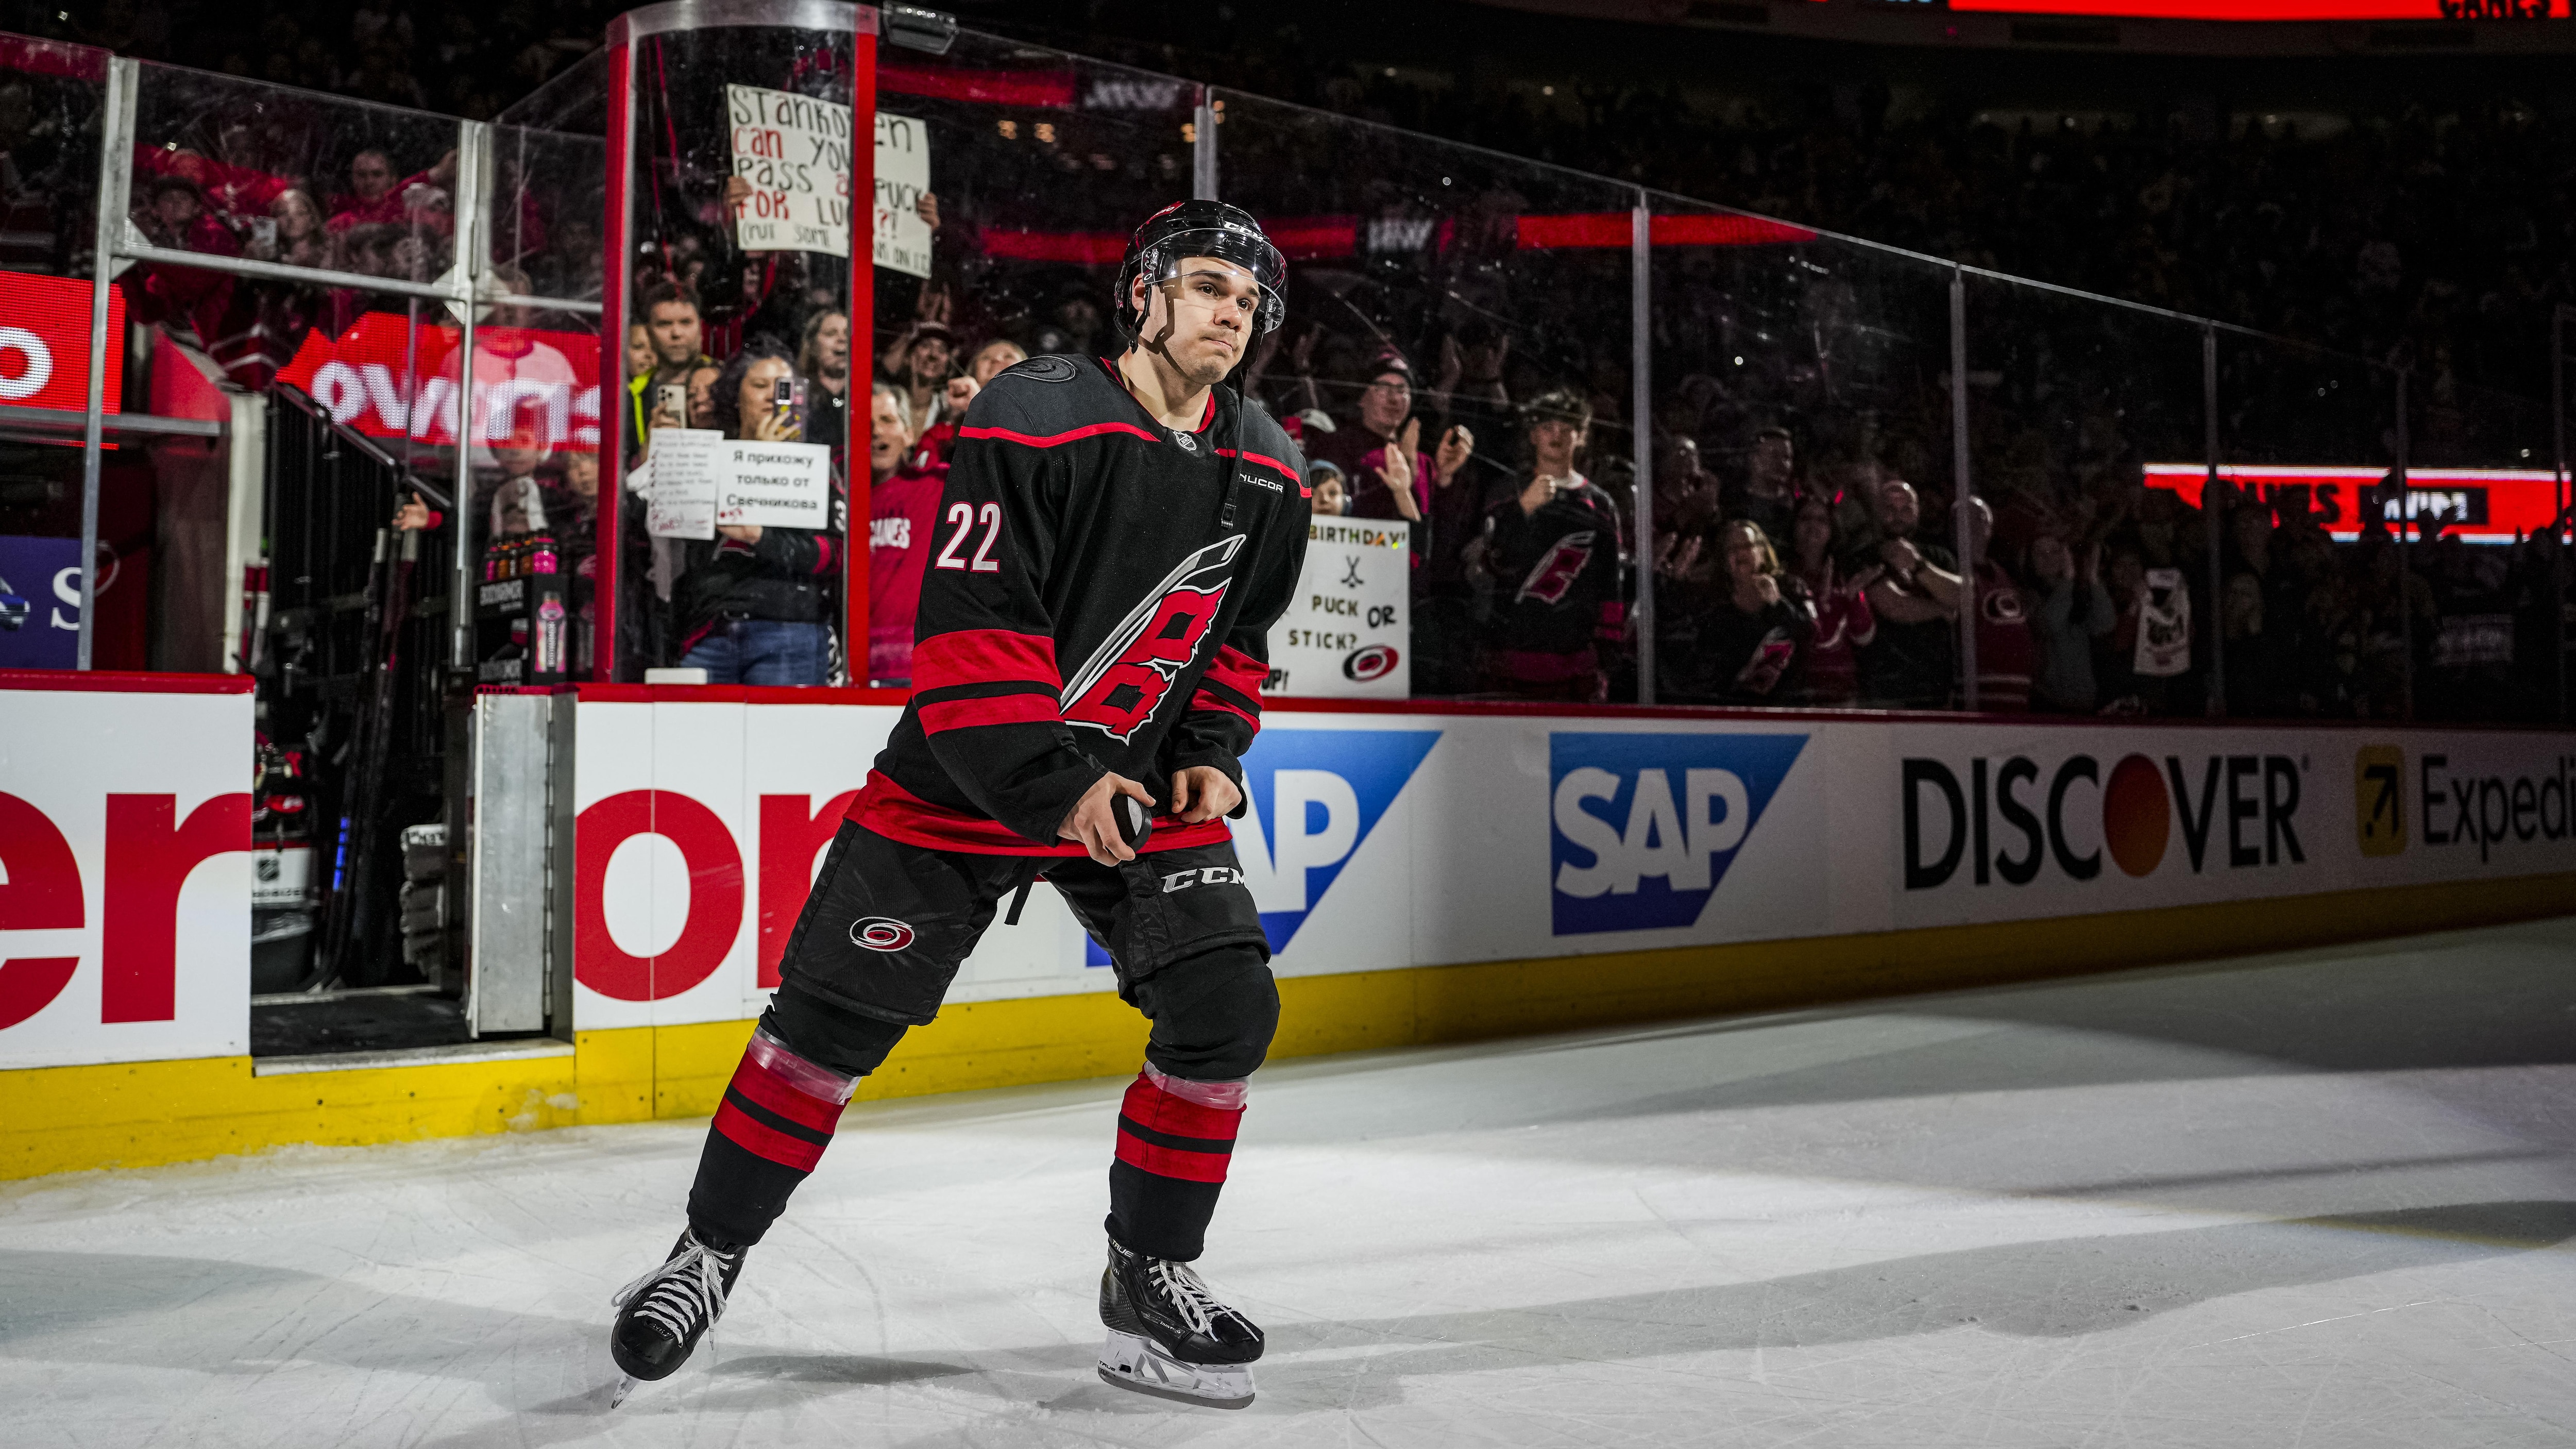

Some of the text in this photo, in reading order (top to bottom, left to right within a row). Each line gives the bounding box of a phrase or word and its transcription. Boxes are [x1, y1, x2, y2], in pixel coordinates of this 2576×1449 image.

[733, 450, 743, 462] Я
[736, 474, 810, 487] только от
[1239, 473, 1283, 494] NUCOR
[726, 493, 818, 510] Свечникова
[934, 501, 1002, 574] 22
[1312, 595, 1397, 629] PUCK OR
[1289, 629, 1358, 650] STICK?
[1554, 766, 1749, 899] SAP
[1160, 867, 1245, 894] CCM
[1112, 1238, 1134, 1258] TRUE
[1099, 1360, 1116, 1372] TRUE
